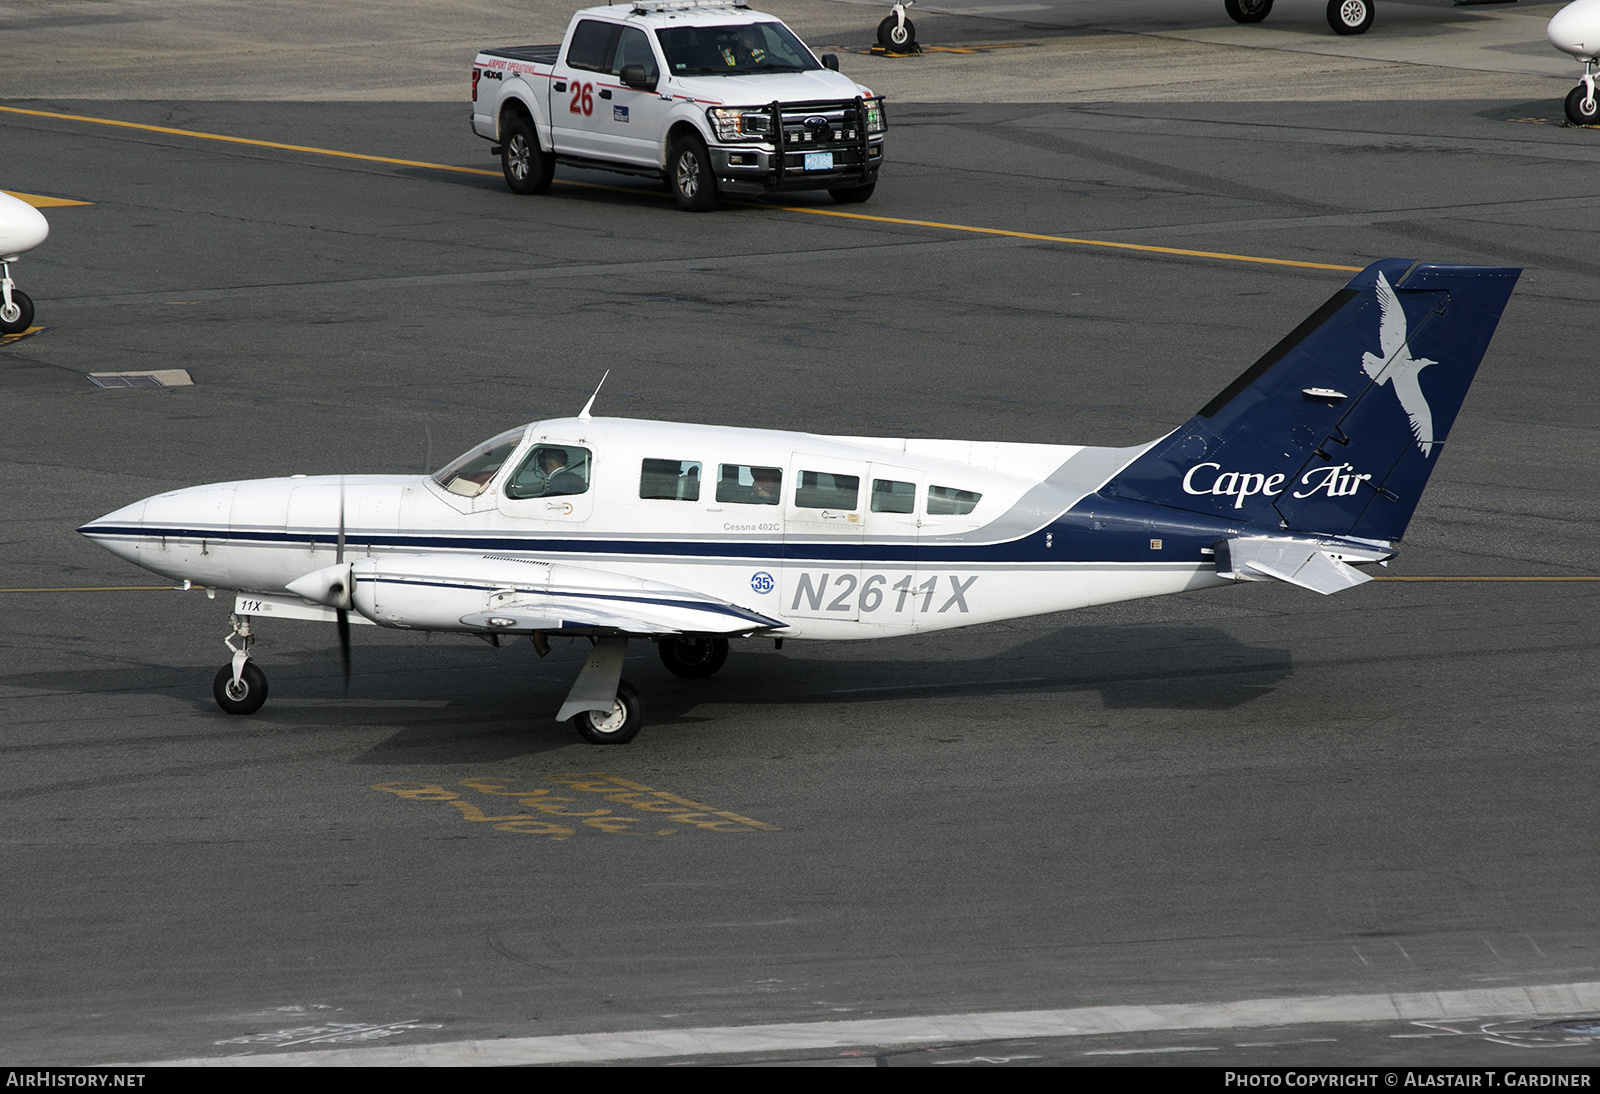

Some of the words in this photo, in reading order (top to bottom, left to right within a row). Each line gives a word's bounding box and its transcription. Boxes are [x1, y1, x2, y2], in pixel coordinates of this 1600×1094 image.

[488, 59, 507, 70] AIRPORT
[507, 61, 535, 74] OPERATIONS
[569, 80, 594, 117] 26
[1182, 462, 1285, 509] Cape
[1293, 462, 1372, 499] Air
[723, 522, 756, 531] Cessna
[757, 523, 780, 531] 402C
[755, 576, 770, 590] 35
[791, 572, 979, 613] N2611X
[241, 600, 262, 612] 11X
